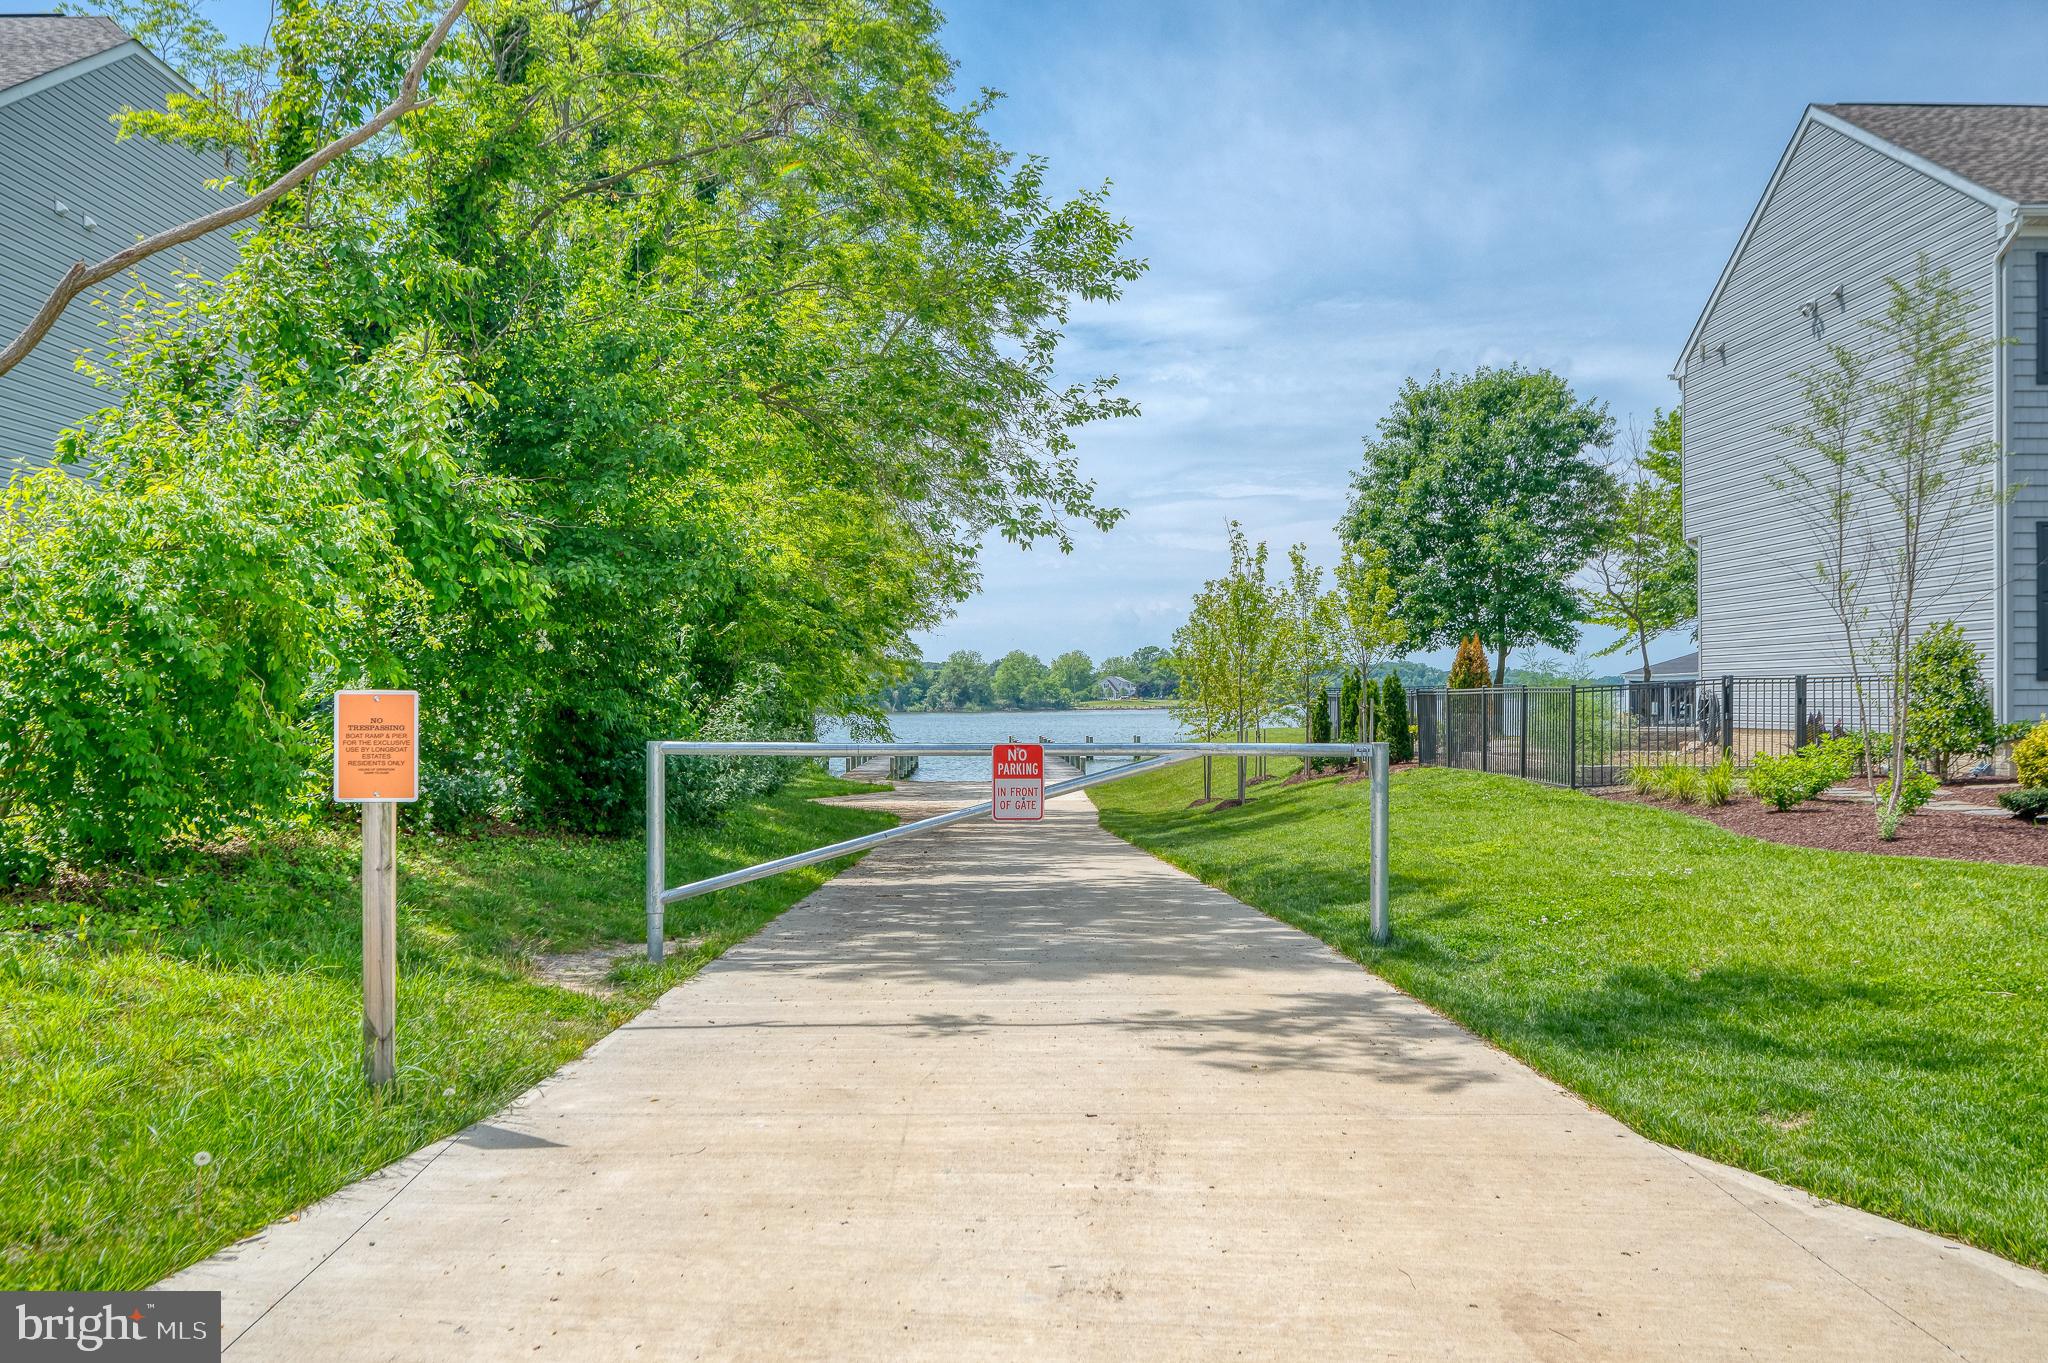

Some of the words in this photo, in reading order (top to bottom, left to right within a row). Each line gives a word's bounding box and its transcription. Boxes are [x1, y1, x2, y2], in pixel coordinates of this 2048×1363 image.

[1008, 749, 1028, 762] NO
[998, 763, 1038, 775] PARKING
[998, 788, 1006, 796] IN
[1010, 788, 1038, 796] FRONT
[1000, 800, 1011, 810] OF
[1015, 800, 1036, 810] GATE
